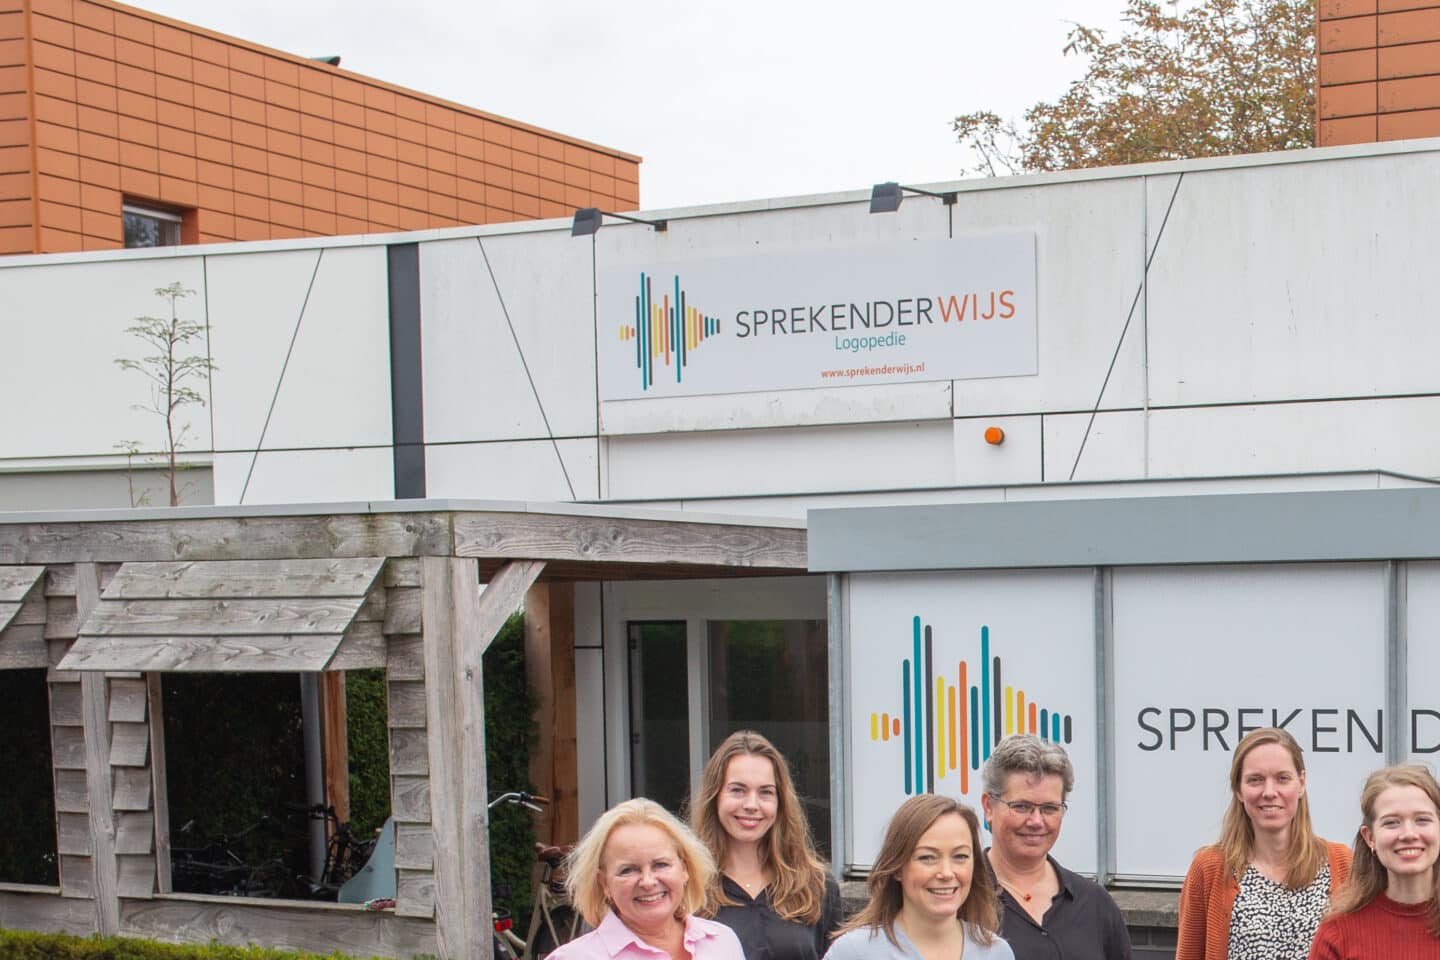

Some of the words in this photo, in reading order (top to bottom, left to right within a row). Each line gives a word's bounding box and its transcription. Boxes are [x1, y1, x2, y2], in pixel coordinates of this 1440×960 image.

[736, 290, 1016, 338] SPREKENDERWIJS
[834, 333, 906, 353] Logopedie
[821, 363, 925, 378] www.sprekenderwijs.nl
